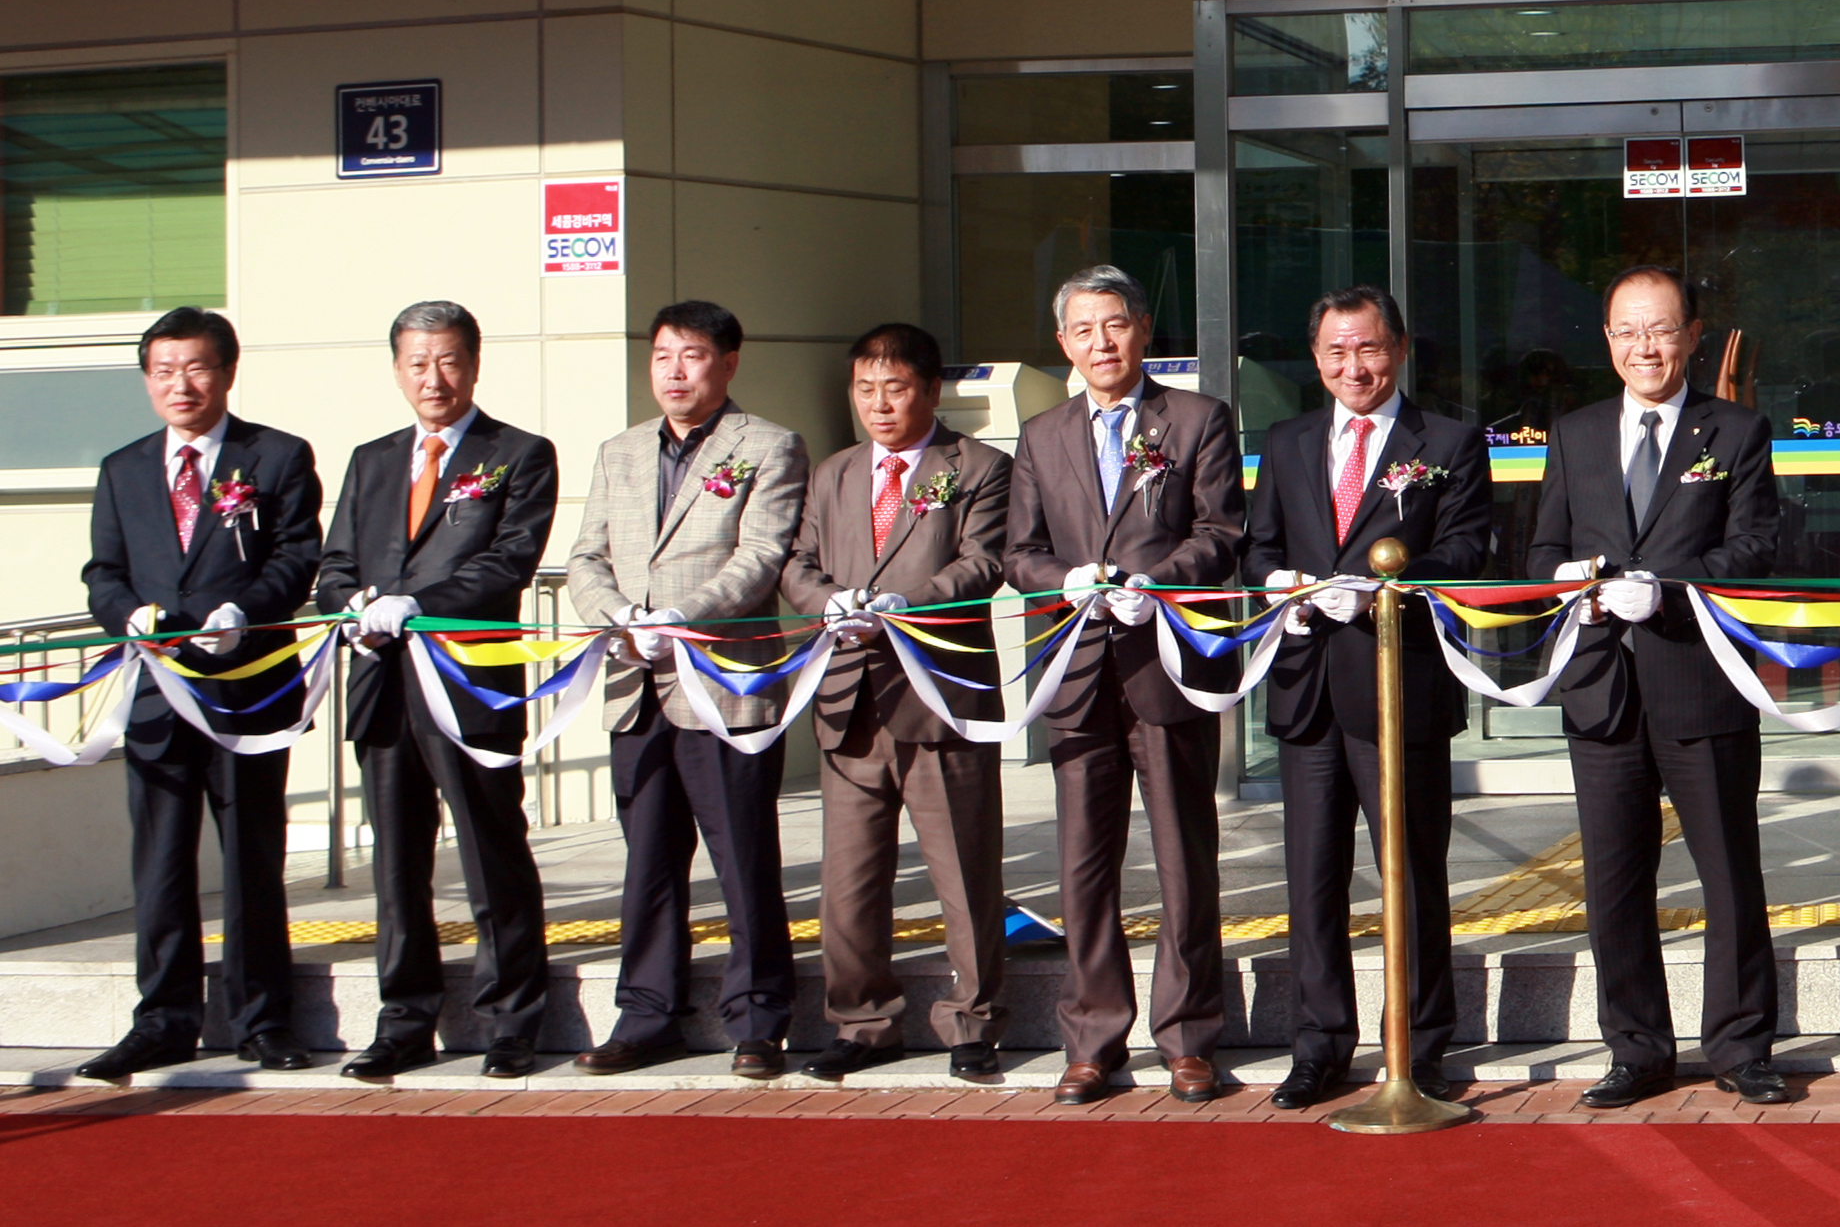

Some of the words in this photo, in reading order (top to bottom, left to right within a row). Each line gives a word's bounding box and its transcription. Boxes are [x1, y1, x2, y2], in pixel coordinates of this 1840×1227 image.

[354, 93, 422, 113] 컨벤시아대로
[365, 114, 409, 150] 43
[1630, 173, 1679, 186] SECOM
[1691, 171, 1740, 185] SECOM
[551, 212, 613, 229] 세콤경비구역
[547, 237, 616, 259] SECOM
